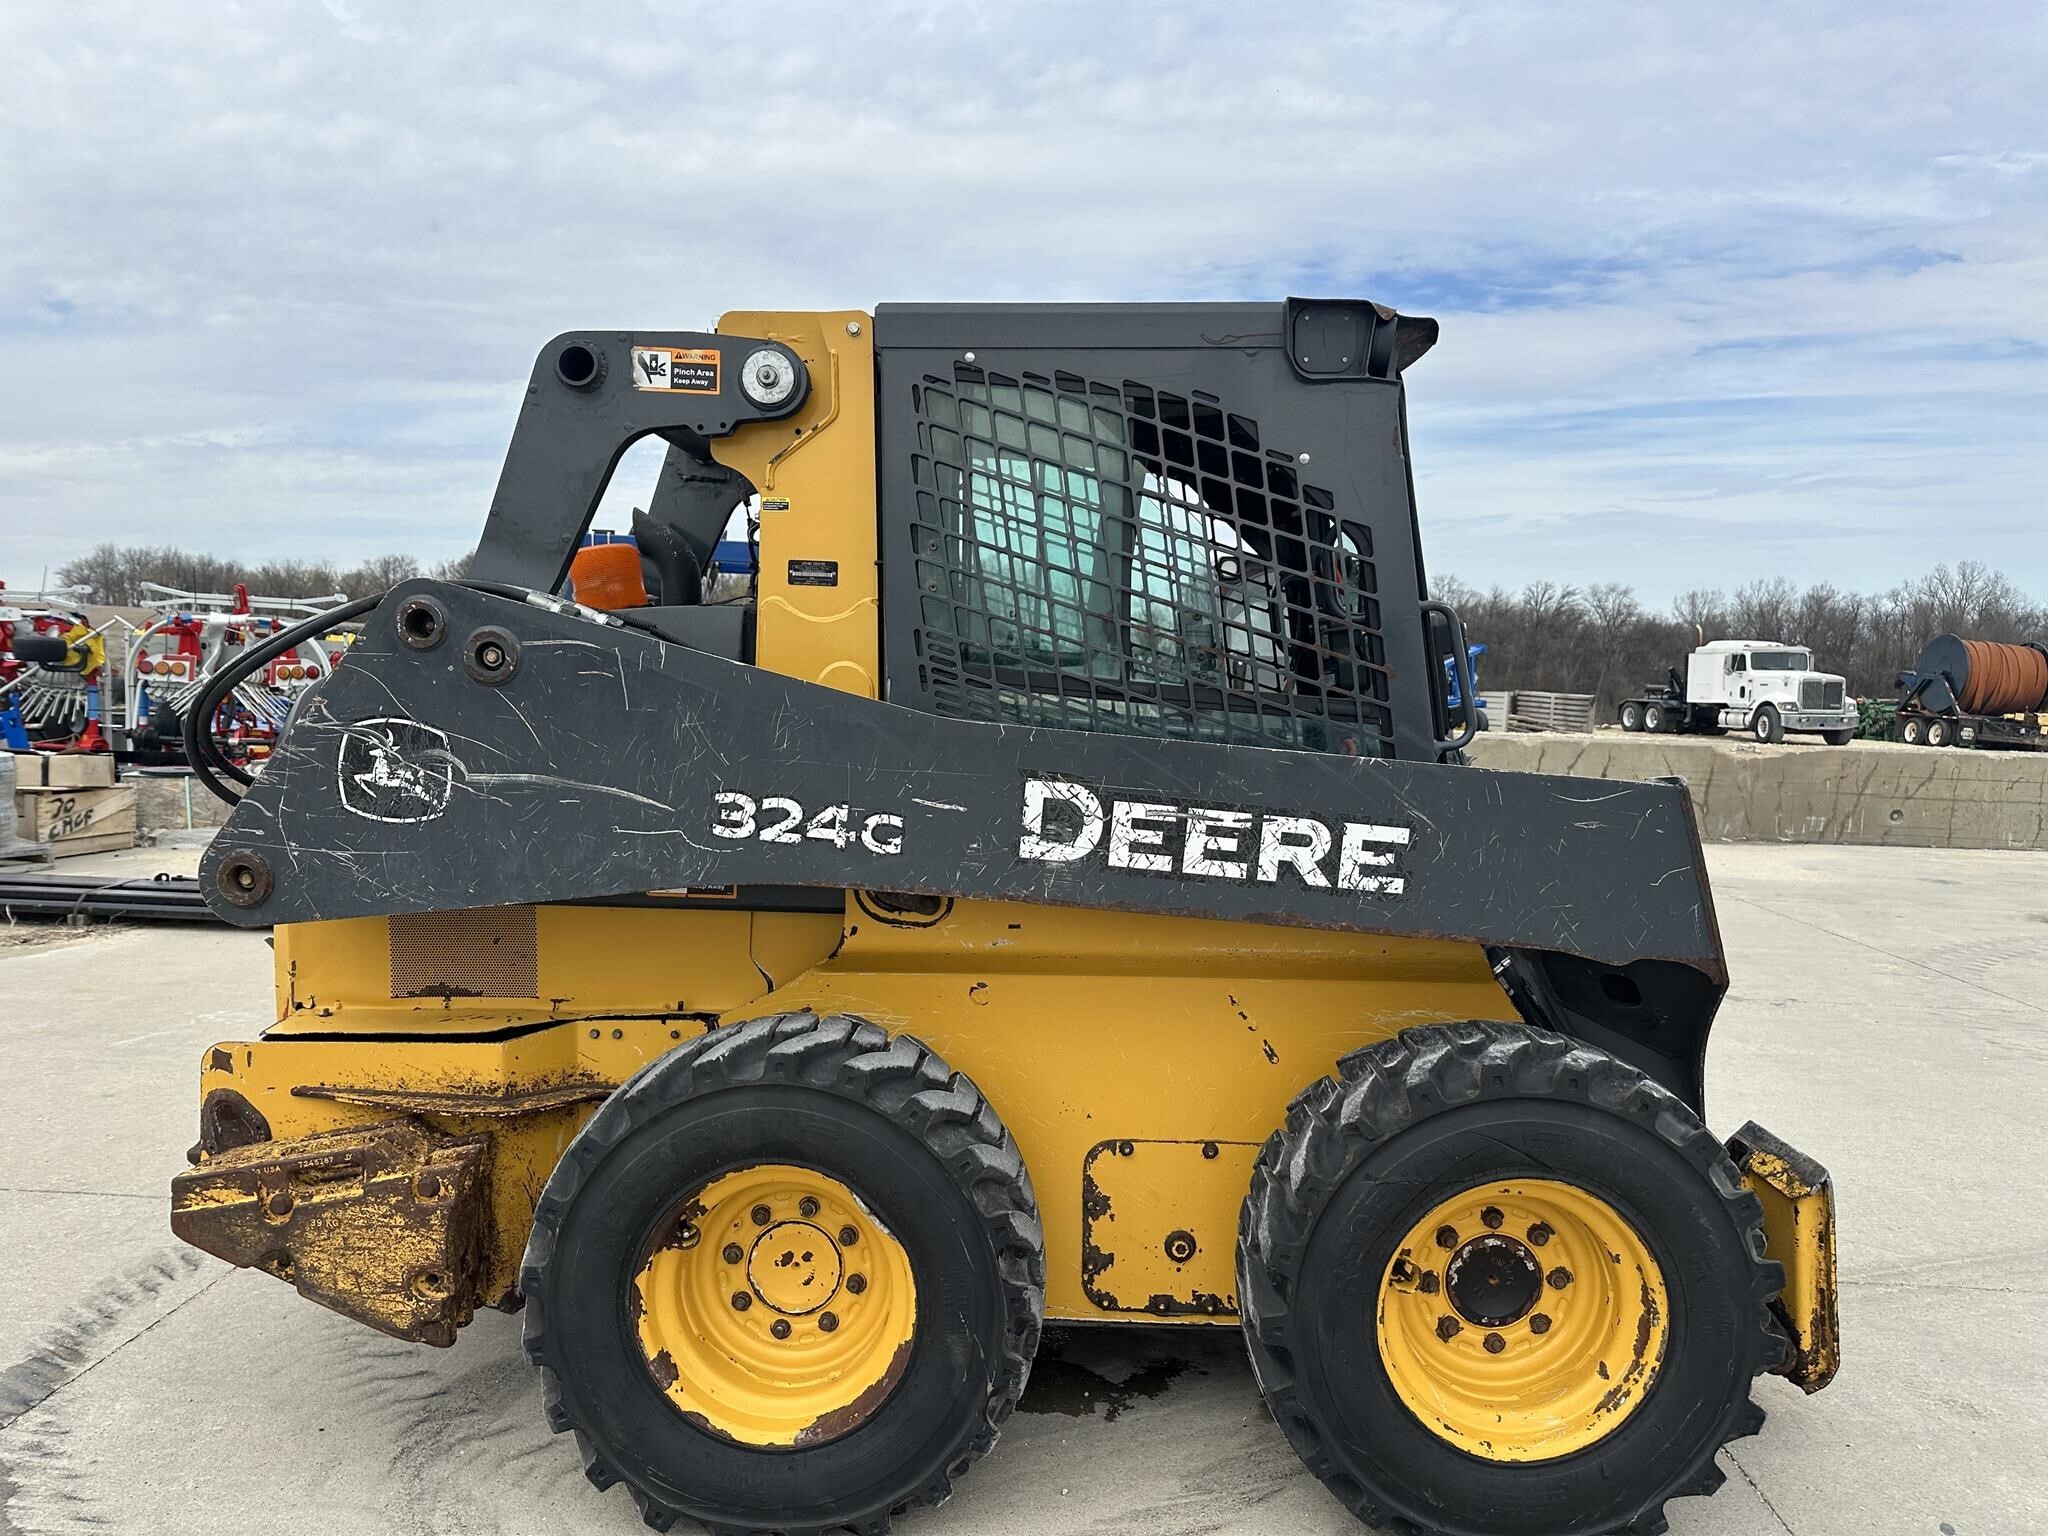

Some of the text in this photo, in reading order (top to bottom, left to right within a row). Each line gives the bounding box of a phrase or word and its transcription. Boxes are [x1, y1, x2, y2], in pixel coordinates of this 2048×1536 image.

[682, 353, 716, 361] WARNING
[674, 368, 714, 377] Pinch Area
[673, 377, 709, 386] Keep Away
[712, 792, 904, 854] 324G
[1019, 779, 1410, 895] DEERE
[263, 1165, 281, 1173] USA
[310, 1218, 339, 1228] 39 KG
